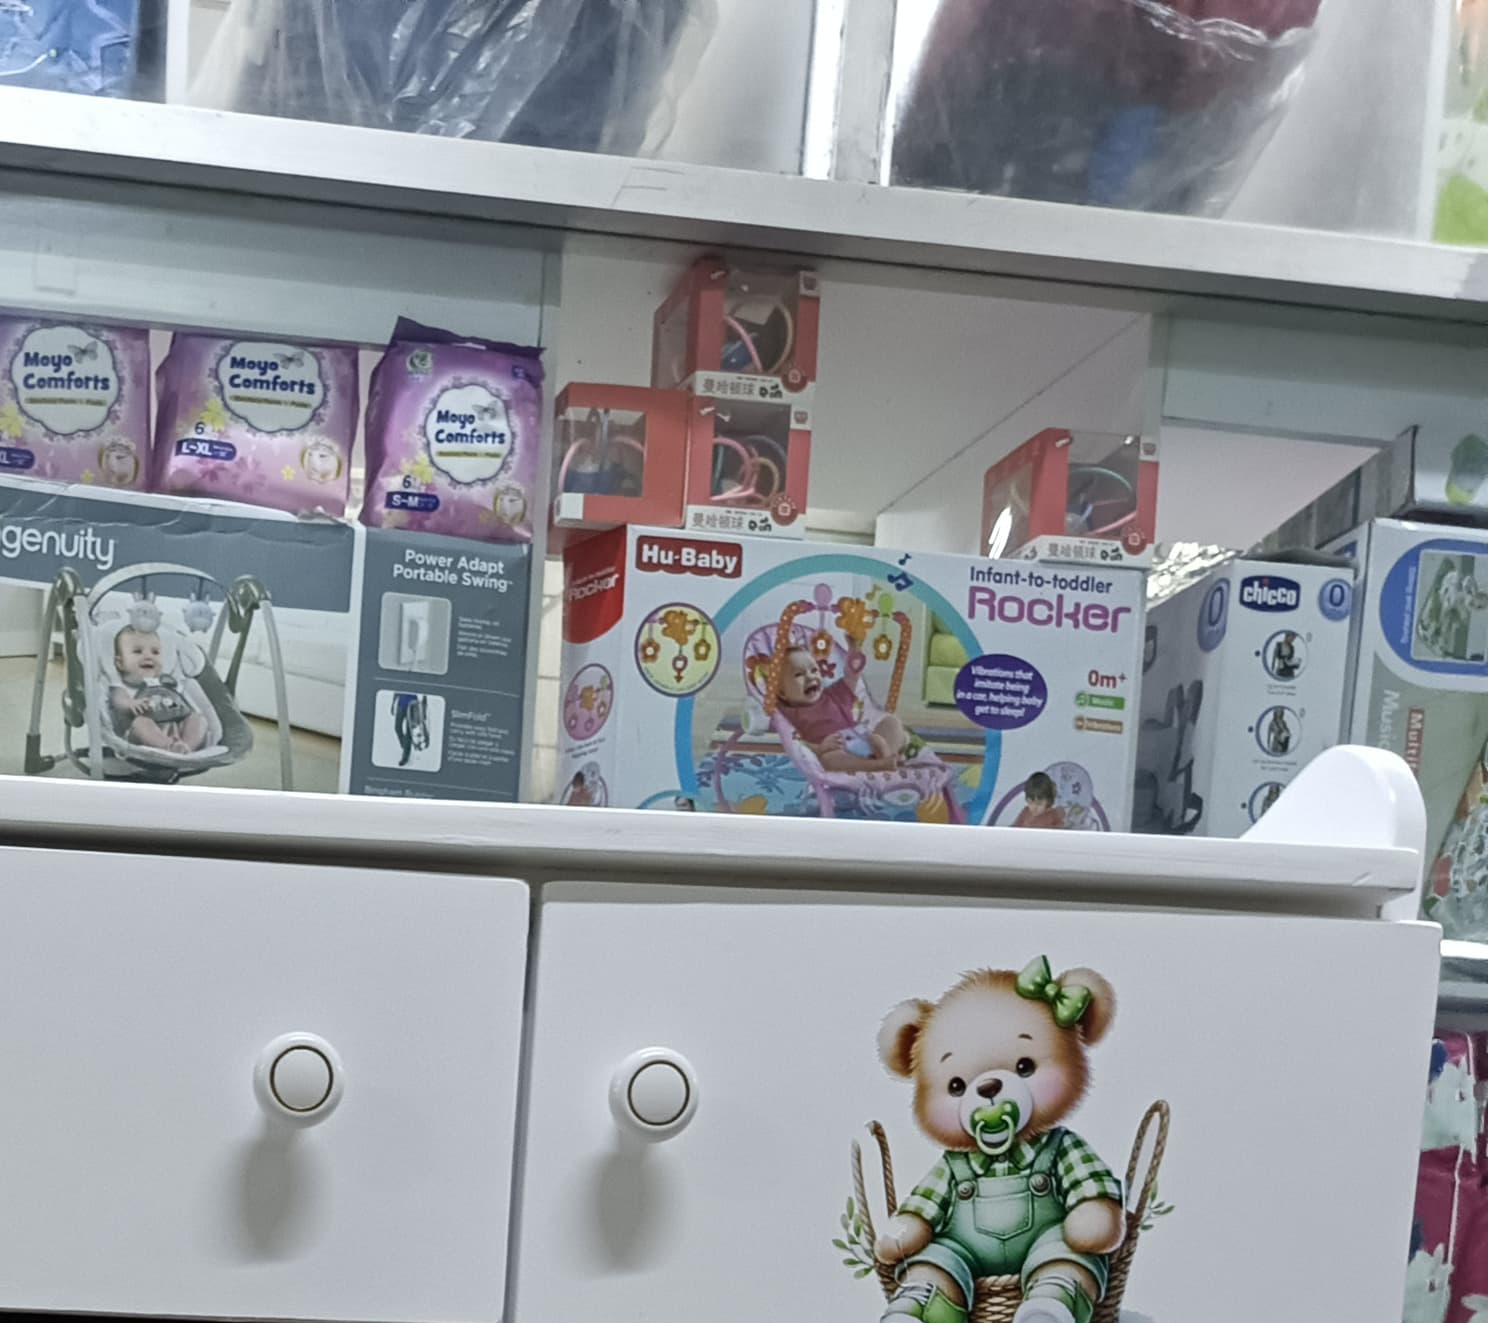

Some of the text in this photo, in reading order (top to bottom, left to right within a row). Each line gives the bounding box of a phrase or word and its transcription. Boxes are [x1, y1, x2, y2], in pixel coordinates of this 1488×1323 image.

[24, 352, 73, 373] Moyo
[230, 356, 279, 376] Moyo
[23, 371, 110, 391] Comforts
[229, 374, 315, 395] Comforts
[195, 421, 205, 435] 6
[436, 410, 476, 429] Moyo
[435, 429, 505, 444] Comforts
[402, 475, 411, 489] 6
[405, 549, 504, 575] Power Adapt
[642, 543, 737, 574] Hu-Baby
[393, 564, 458, 585] Portable
[970, 566, 1113, 593] Infant-to-toddler
[1243, 579, 1297, 605] chicco
[968, 586, 1132, 633] Rocker
